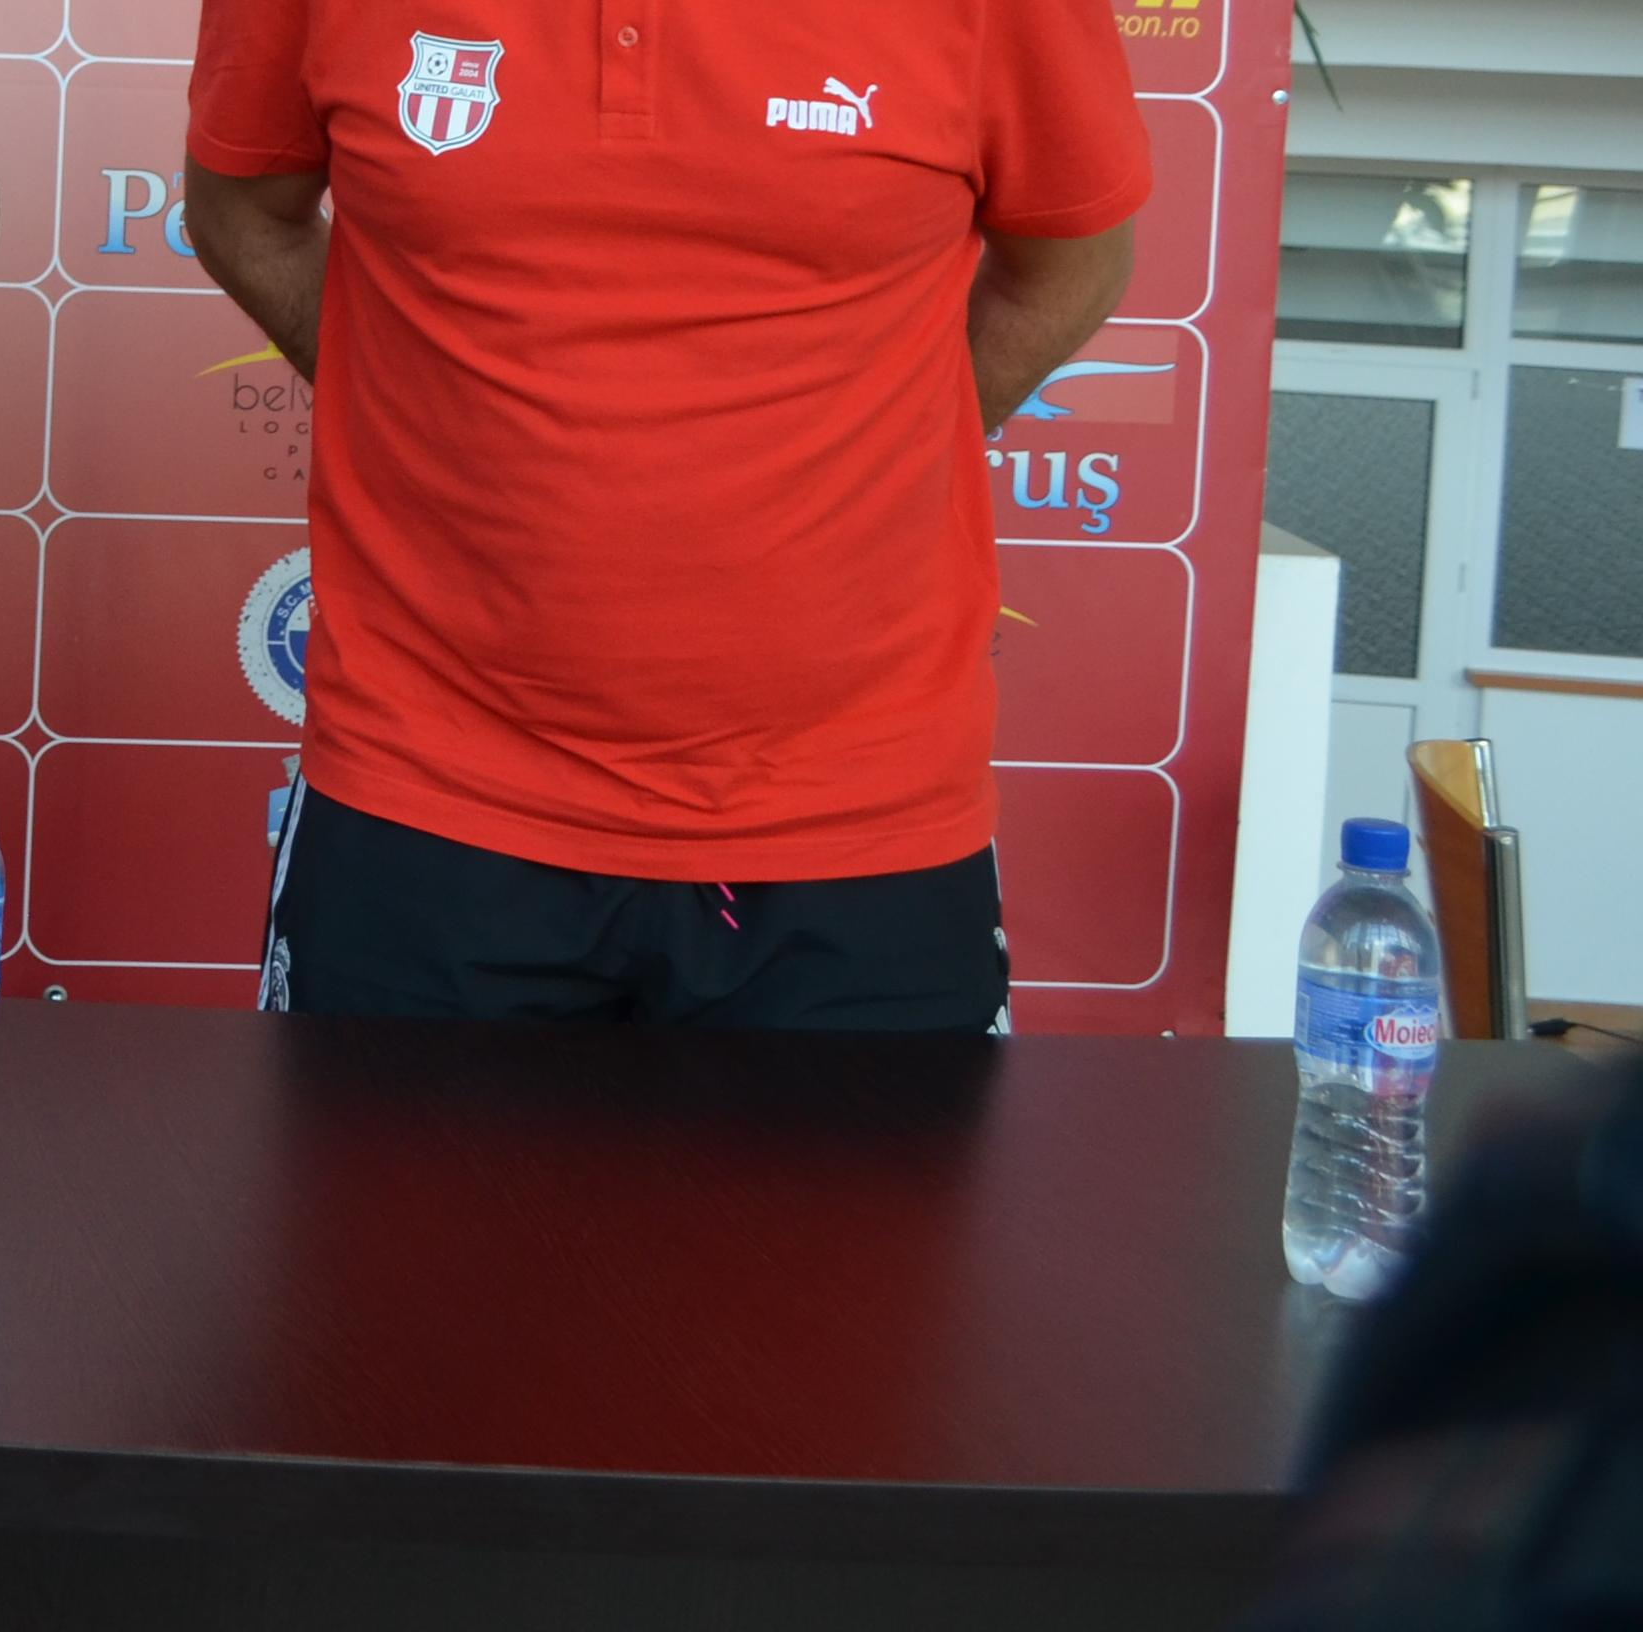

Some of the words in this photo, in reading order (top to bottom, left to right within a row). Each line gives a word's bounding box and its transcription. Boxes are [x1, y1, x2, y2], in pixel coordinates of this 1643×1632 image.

[413, 82, 449, 95] UNITED
[451, 86, 485, 99] GALATI
[767, 97, 857, 136] PUMA
[1374, 1017, 1437, 1048] Moiec
